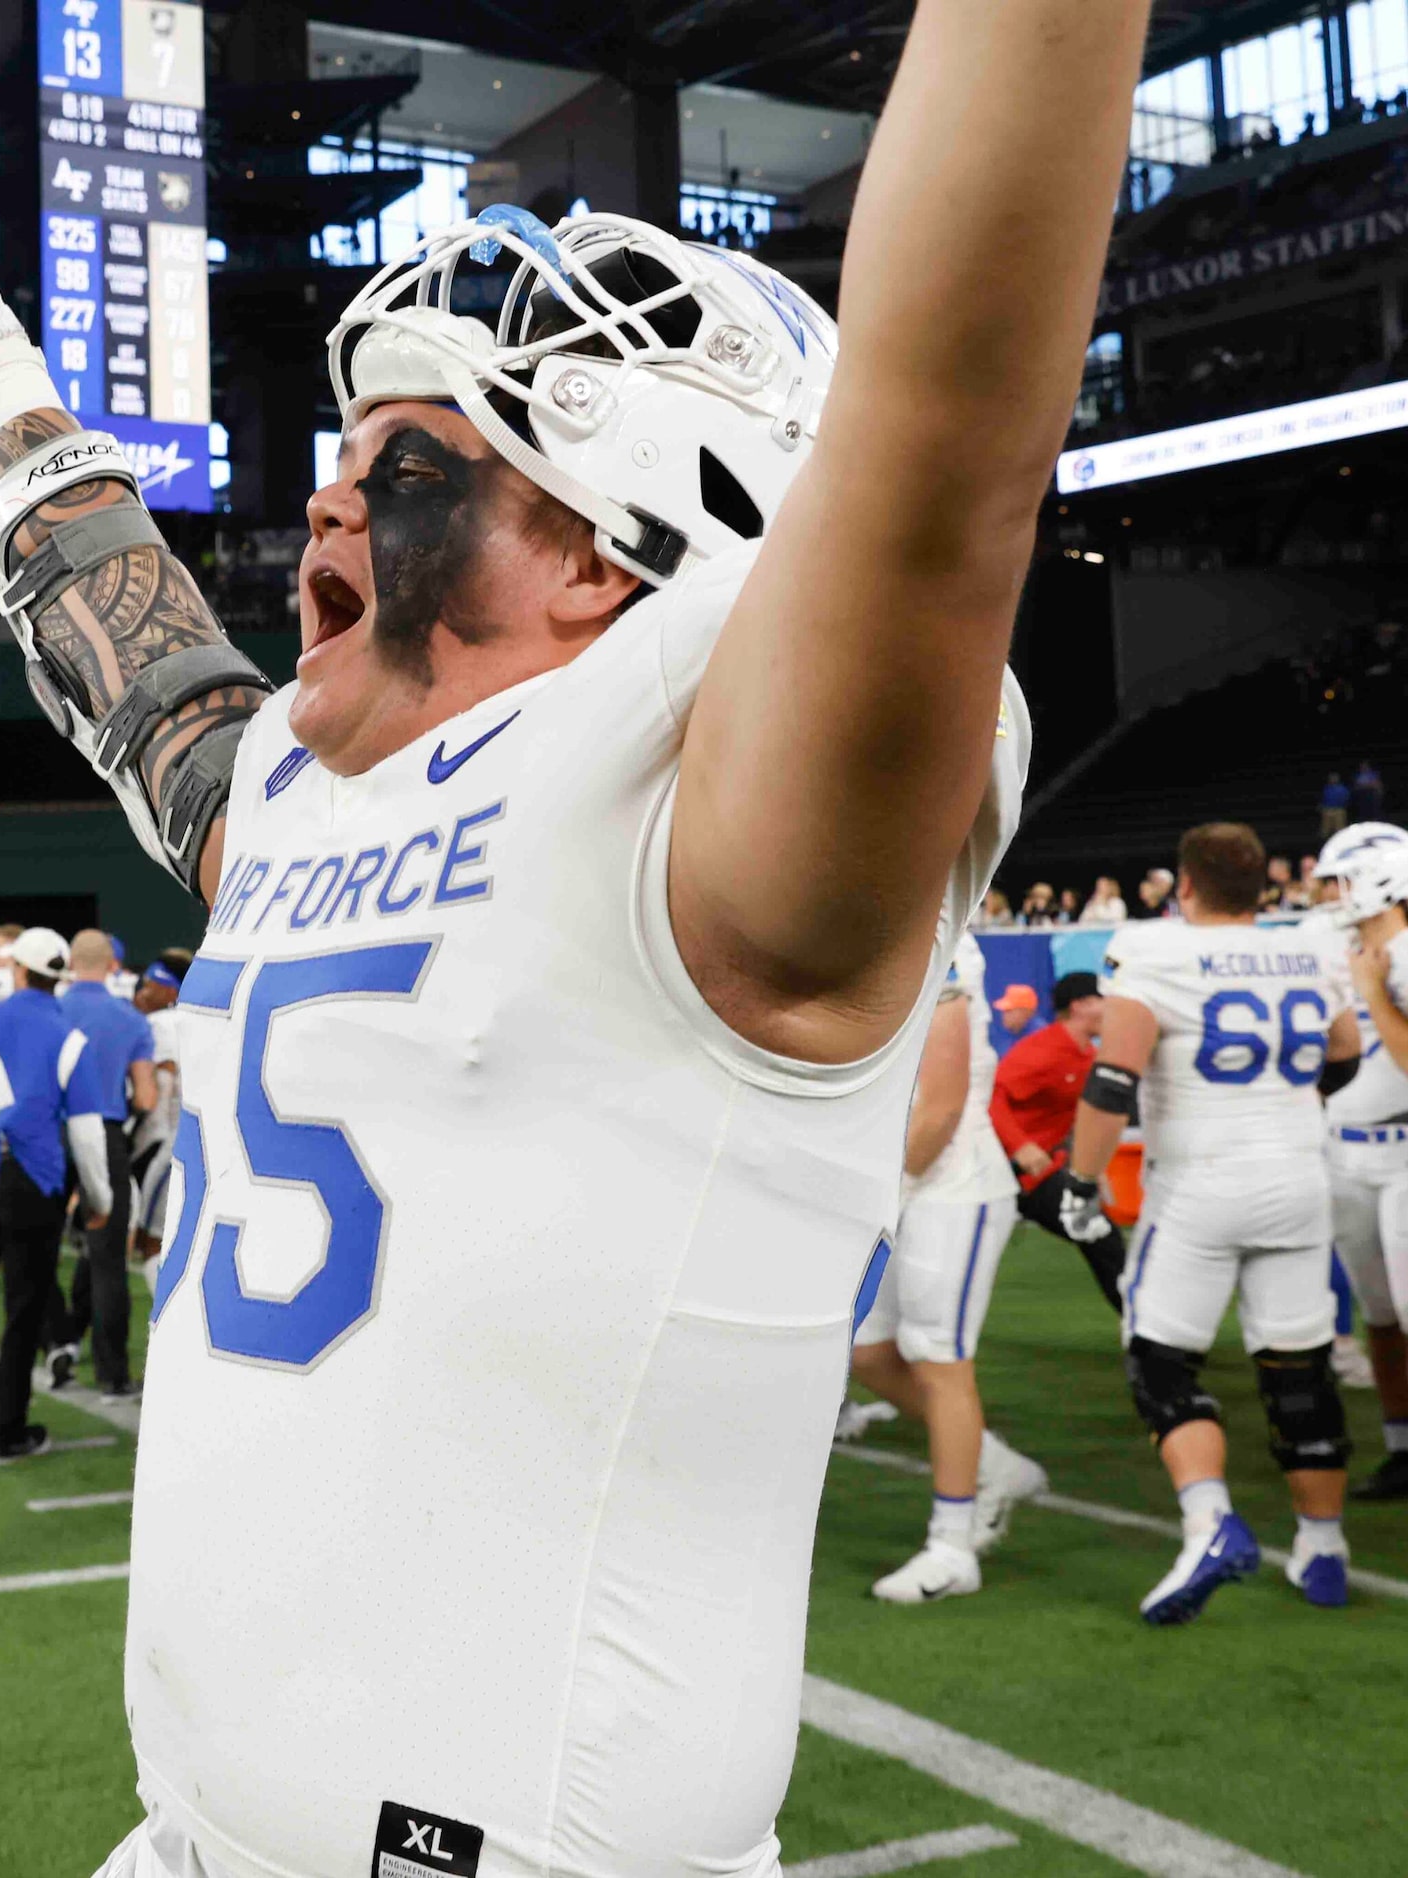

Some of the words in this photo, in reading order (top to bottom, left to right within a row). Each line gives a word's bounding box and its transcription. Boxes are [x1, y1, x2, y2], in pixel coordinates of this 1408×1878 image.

[63, 28, 101, 80] 13
[151, 41, 175, 88] 7
[48, 216, 96, 253] 325
[56, 257, 90, 292] 98
[1126, 249, 1242, 305] LUXOR
[1252, 209, 1408, 271] STAFFIN
[50, 296, 96, 332] 227
[61, 337, 87, 371] 18
[249, 796, 507, 935] FORCE
[1195, 989, 1328, 1086] 66
[401, 1819, 453, 1861] XL
